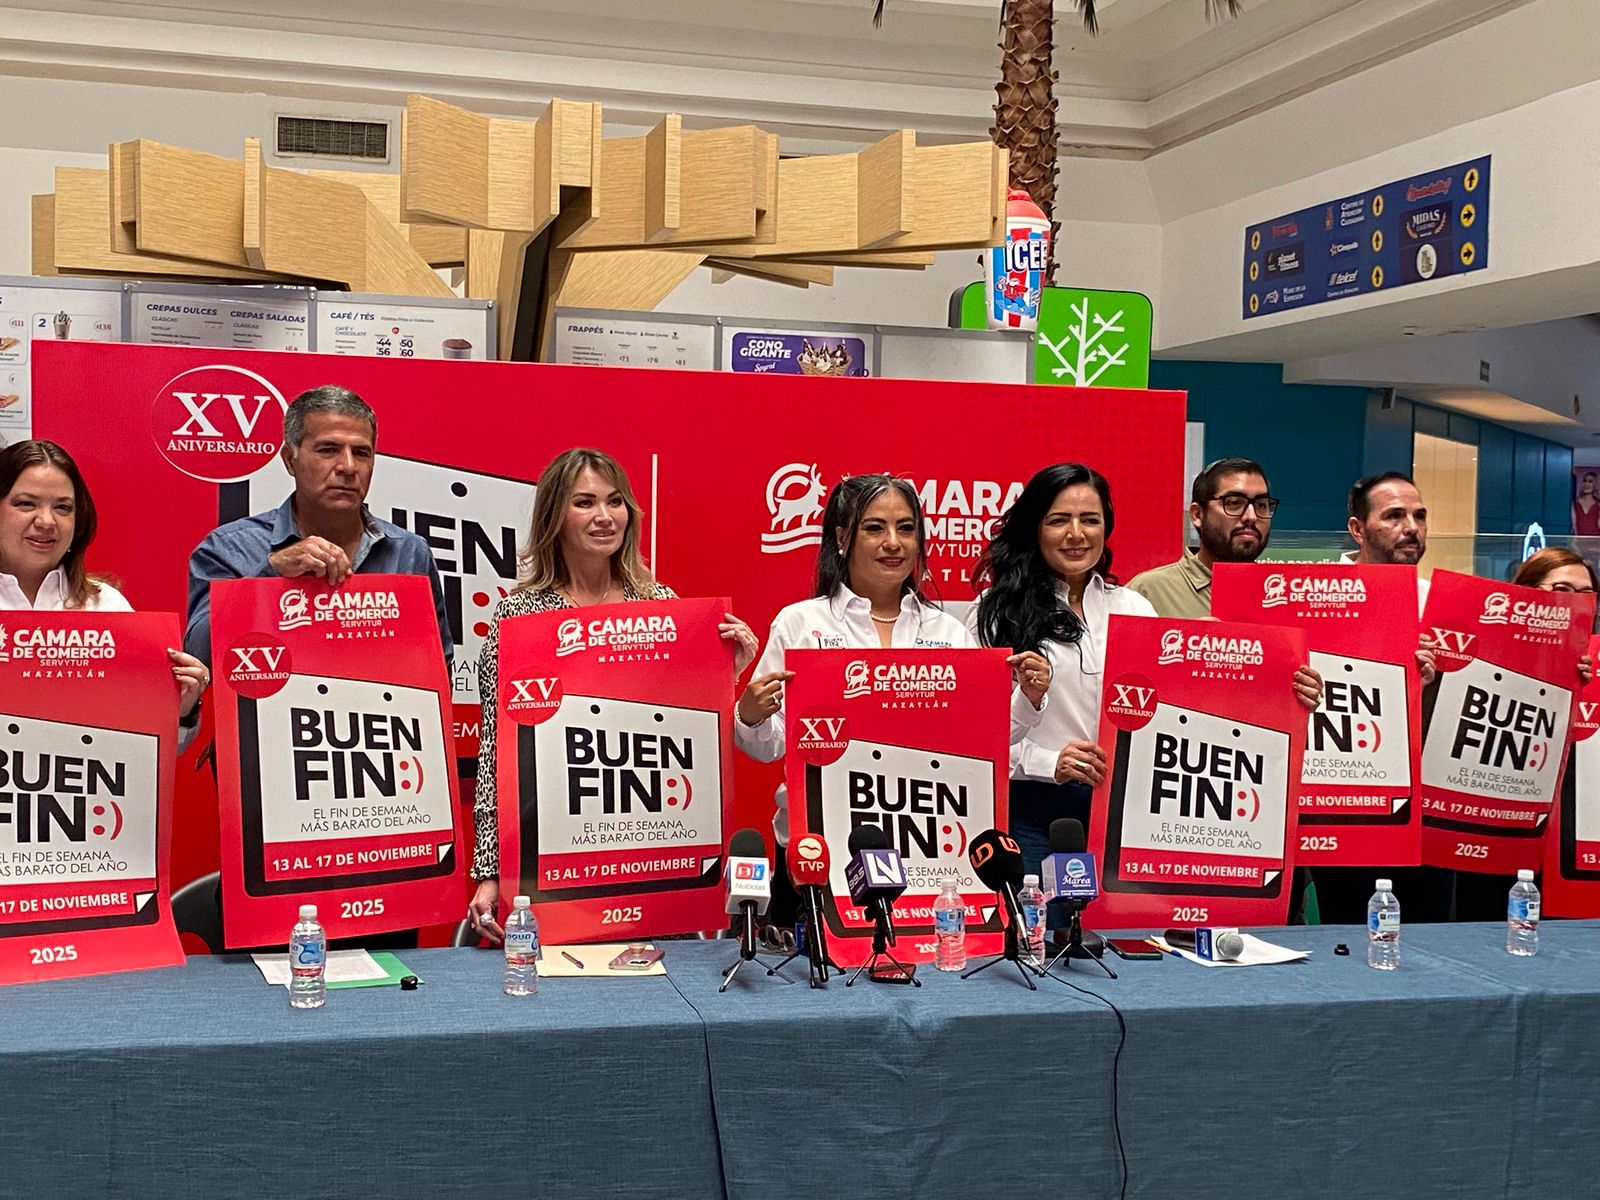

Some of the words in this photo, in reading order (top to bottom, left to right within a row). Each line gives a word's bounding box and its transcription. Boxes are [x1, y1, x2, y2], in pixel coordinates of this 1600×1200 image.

[1412, 209, 1440, 229] MIDAS
[1006, 240, 1047, 271] ICEE
[147, 304, 181, 313] CREPAS
[183, 306, 217, 316] DULCES
[230, 310, 264, 320] CREPAS
[266, 313, 306, 323] SALADAS
[330, 311, 352, 320] CAFÉ
[360, 313, 375, 321] TÉS
[38, 319, 46, 328] 2
[568, 325, 604, 334] FRAPPÉS
[748, 340, 784, 350] CONO
[740, 348, 792, 359] GIGANTE
[172, 391, 271, 439] XV
[166, 439, 275, 454] ANIVERSARIO
[1290, 576, 1366, 593] CÁMARA
[313, 590, 399, 608] CÁMARA
[1290, 593, 1305, 602] DE
[1306, 592, 1367, 602] COMERCIO
[315, 610, 334, 622] DE
[337, 607, 400, 620] COMERCIO
[1512, 601, 1571, 620] CÁMARA
[341, 620, 382, 628] SERVYTUR
[588, 615, 676, 636] CÁMARA
[1510, 614, 1525, 625] DE
[13, 627, 115, 647] CÁMARA
[326, 628, 395, 640] MAZATLÁN
[588, 635, 606, 646] DE
[608, 631, 677, 645] COMERCIO
[1430, 627, 1476, 653] XV
[612, 643, 655, 651] SERVYTUR
[1187, 634, 1264, 655] CÁMARA
[13, 648, 33, 659] DE
[37, 647, 115, 659] COMERCIO
[231, 646, 286, 673] XV
[598, 652, 670, 663] MAZATLÁN
[1186, 651, 1201, 660] DE
[1203, 651, 1263, 665] COMERCIO
[40, 659, 89, 667] SERVYTUR
[1205, 661, 1242, 670] SERVYTUR
[23, 668, 105, 678] MAZATLÁN
[229, 671, 290, 682] ANIVERSARIO
[874, 663, 957, 681] CÁMARA
[1192, 671, 1254, 681] MAZATLÁN
[510, 677, 558, 703] XV
[874, 681, 890, 692] DE
[892, 680, 957, 691] COMERCIO
[895, 691, 935, 699] SERVYTUR
[1111, 684, 1155, 709] XV
[507, 700, 560, 711] ANIVERSARIO
[882, 700, 948, 708] MAZATLÁN
[1461, 685, 1556, 738] BUEN
[1107, 706, 1154, 718] ANIVERSARIO
[290, 707, 422, 751] BUEN
[800, 718, 846, 741] XV
[565, 726, 693, 769] BUEN
[797, 741, 848, 749] ANIVERSARIO
[1153, 732, 1264, 785] BUEN
[1313, 758, 1326, 767] DE
[1329, 759, 1373, 769] SEMANA
[1303, 769, 1337, 778] ARATO
[1340, 769, 1359, 779] DEL
[1362, 768, 1387, 779] AÑO
[1459, 767, 1468, 777] EL
[1471, 769, 1486, 780] FIN
[1487, 772, 1501, 782] DE
[1501, 775, 1535, 786] SEMANA
[849, 770, 968, 817] BUEN
[1470, 779, 1506, 793] BARATO
[1507, 785, 1522, 794] DEL
[1298, 796, 1313, 806] DE
[1316, 796, 1386, 806] NOVIEMBRE
[313, 808, 326, 819] EL
[330, 807, 348, 818] FIN
[353, 806, 368, 817] DE
[371, 804, 418, 816] SEMANA
[1432, 800, 1446, 811] AL
[1450, 803, 1461, 812] 17
[1464, 806, 1477, 816] DE
[1480, 808, 1536, 821] NOVIEMBRE
[301, 819, 329, 832] MÁS
[333, 818, 381, 831] BARATO
[385, 816, 404, 827] DEL
[407, 812, 431, 824] AÑO
[583, 822, 595, 833] EL
[598, 821, 615, 832] FIN
[618, 820, 633, 831] DE
[636, 819, 683, 830] SEMANA
[571, 832, 597, 845] MÁS
[600, 832, 645, 844] BARATO
[648, 830, 667, 841] DEL
[670, 827, 697, 840] AÑO
[1162, 822, 1173, 832] EL
[1175, 823, 1189, 834] FIN
[1192, 825, 1205, 835] DE
[1207, 827, 1250, 839] SEMANA
[1150, 831, 1173, 844] MÁS
[1175, 835, 1215, 846] BARATO
[1218, 838, 1235, 848] DEL
[1238, 838, 1262, 850] AÑO
[1300, 837, 1338, 850] 2025
[13, 852, 31, 863] FIN
[35, 851, 52, 862] DE
[56, 850, 111, 861] SEMANA
[273, 859, 289, 871] 13
[293, 858, 312, 870] AL
[316, 855, 332, 867] 17
[336, 853, 354, 866] DE
[357, 844, 433, 864] NOVIEMBRE
[1455, 843, 1488, 858] 2025
[1582, 854, 1596, 863] 13
[16, 864, 66, 876] BARATO
[71, 862, 93, 873] DEL
[97, 860, 127, 872] AÑO
[545, 869, 560, 881] 13
[563, 867, 580, 879] AL
[583, 865, 597, 877] 17
[601, 863, 617, 876] DE
[620, 857, 696, 874] NOVIEMBRE
[798, 862, 825, 872] TVP
[915, 866, 960, 876] SEMANA
[1125, 862, 1139, 873] 13
[1141, 863, 1156, 874] AL
[1158, 864, 1172, 875] 17
[1174, 865, 1188, 875] DE
[1191, 865, 1259, 878] NOVIEMBRE
[735, 882, 765, 891] Noticias
[1062, 876, 1091, 885] Marea
[19, 899, 38, 912] DE
[42, 892, 128, 910] NOVIEMBRE
[340, 899, 385, 918] 2025
[601, 906, 642, 924] 2025
[845, 910, 859, 921] 13
[894, 908, 909, 919] DE
[1172, 907, 1209, 922] 2025
[30, 945, 78, 964] 2025
